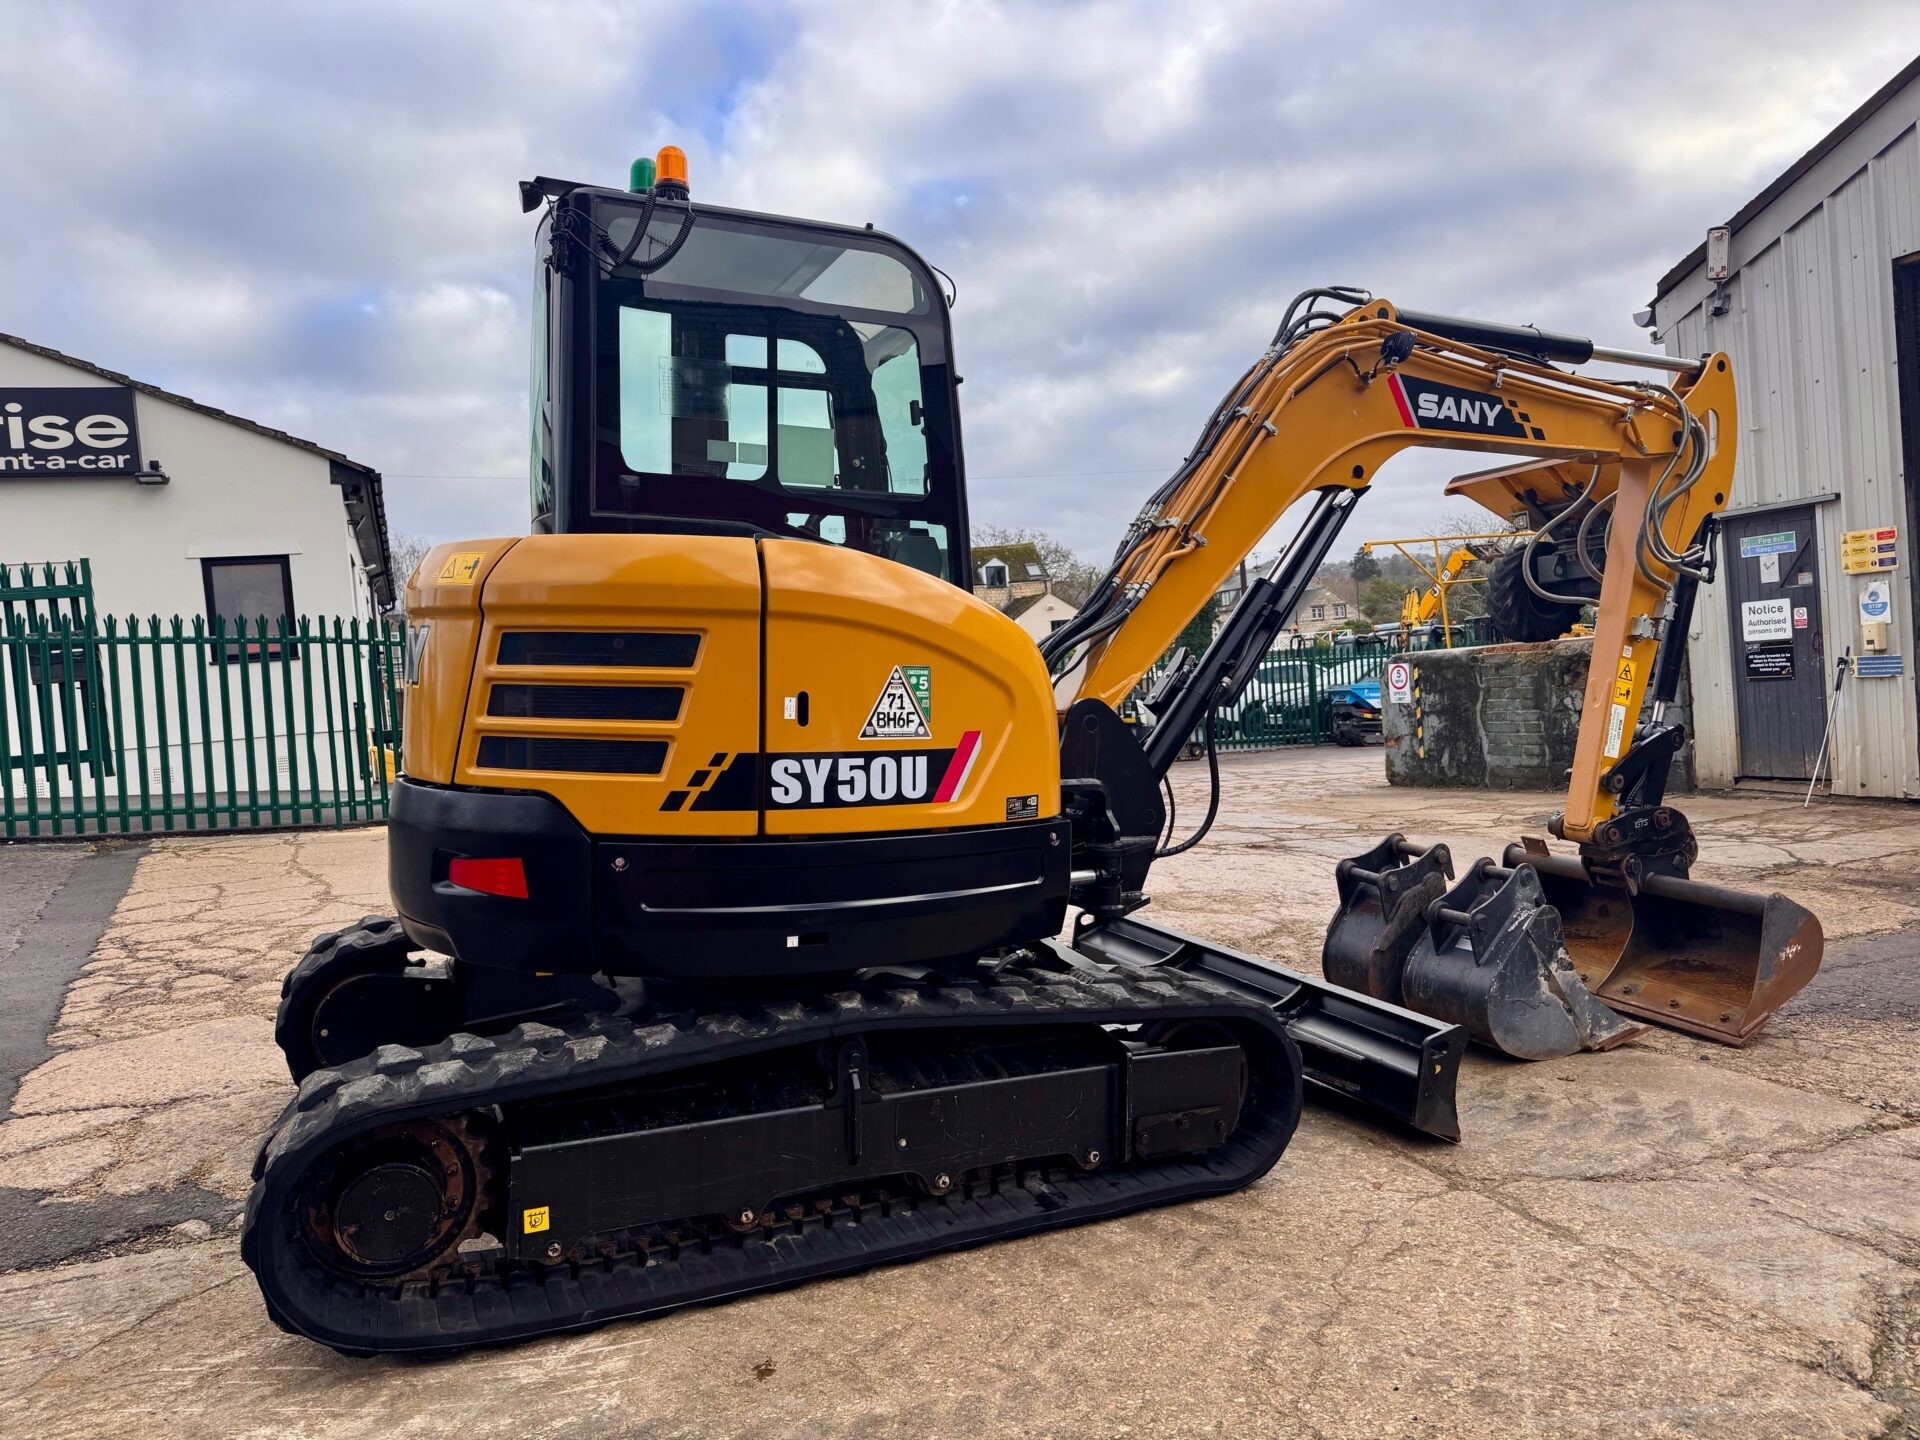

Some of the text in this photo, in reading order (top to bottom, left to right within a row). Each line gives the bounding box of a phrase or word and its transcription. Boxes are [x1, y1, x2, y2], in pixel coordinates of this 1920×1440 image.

[1418, 392, 1502, 427] SANY
[0, 402, 129, 450] ise
[1748, 604, 1784, 616] Notice
[1748, 617, 1786, 627] Authorised
[1748, 628, 1772, 636] persons
[1396, 670, 1401, 678] 5
[919, 676, 928, 690] 5
[887, 693, 905, 710] 71
[877, 712, 915, 728] BH6F
[771, 756, 927, 804] SY50U
